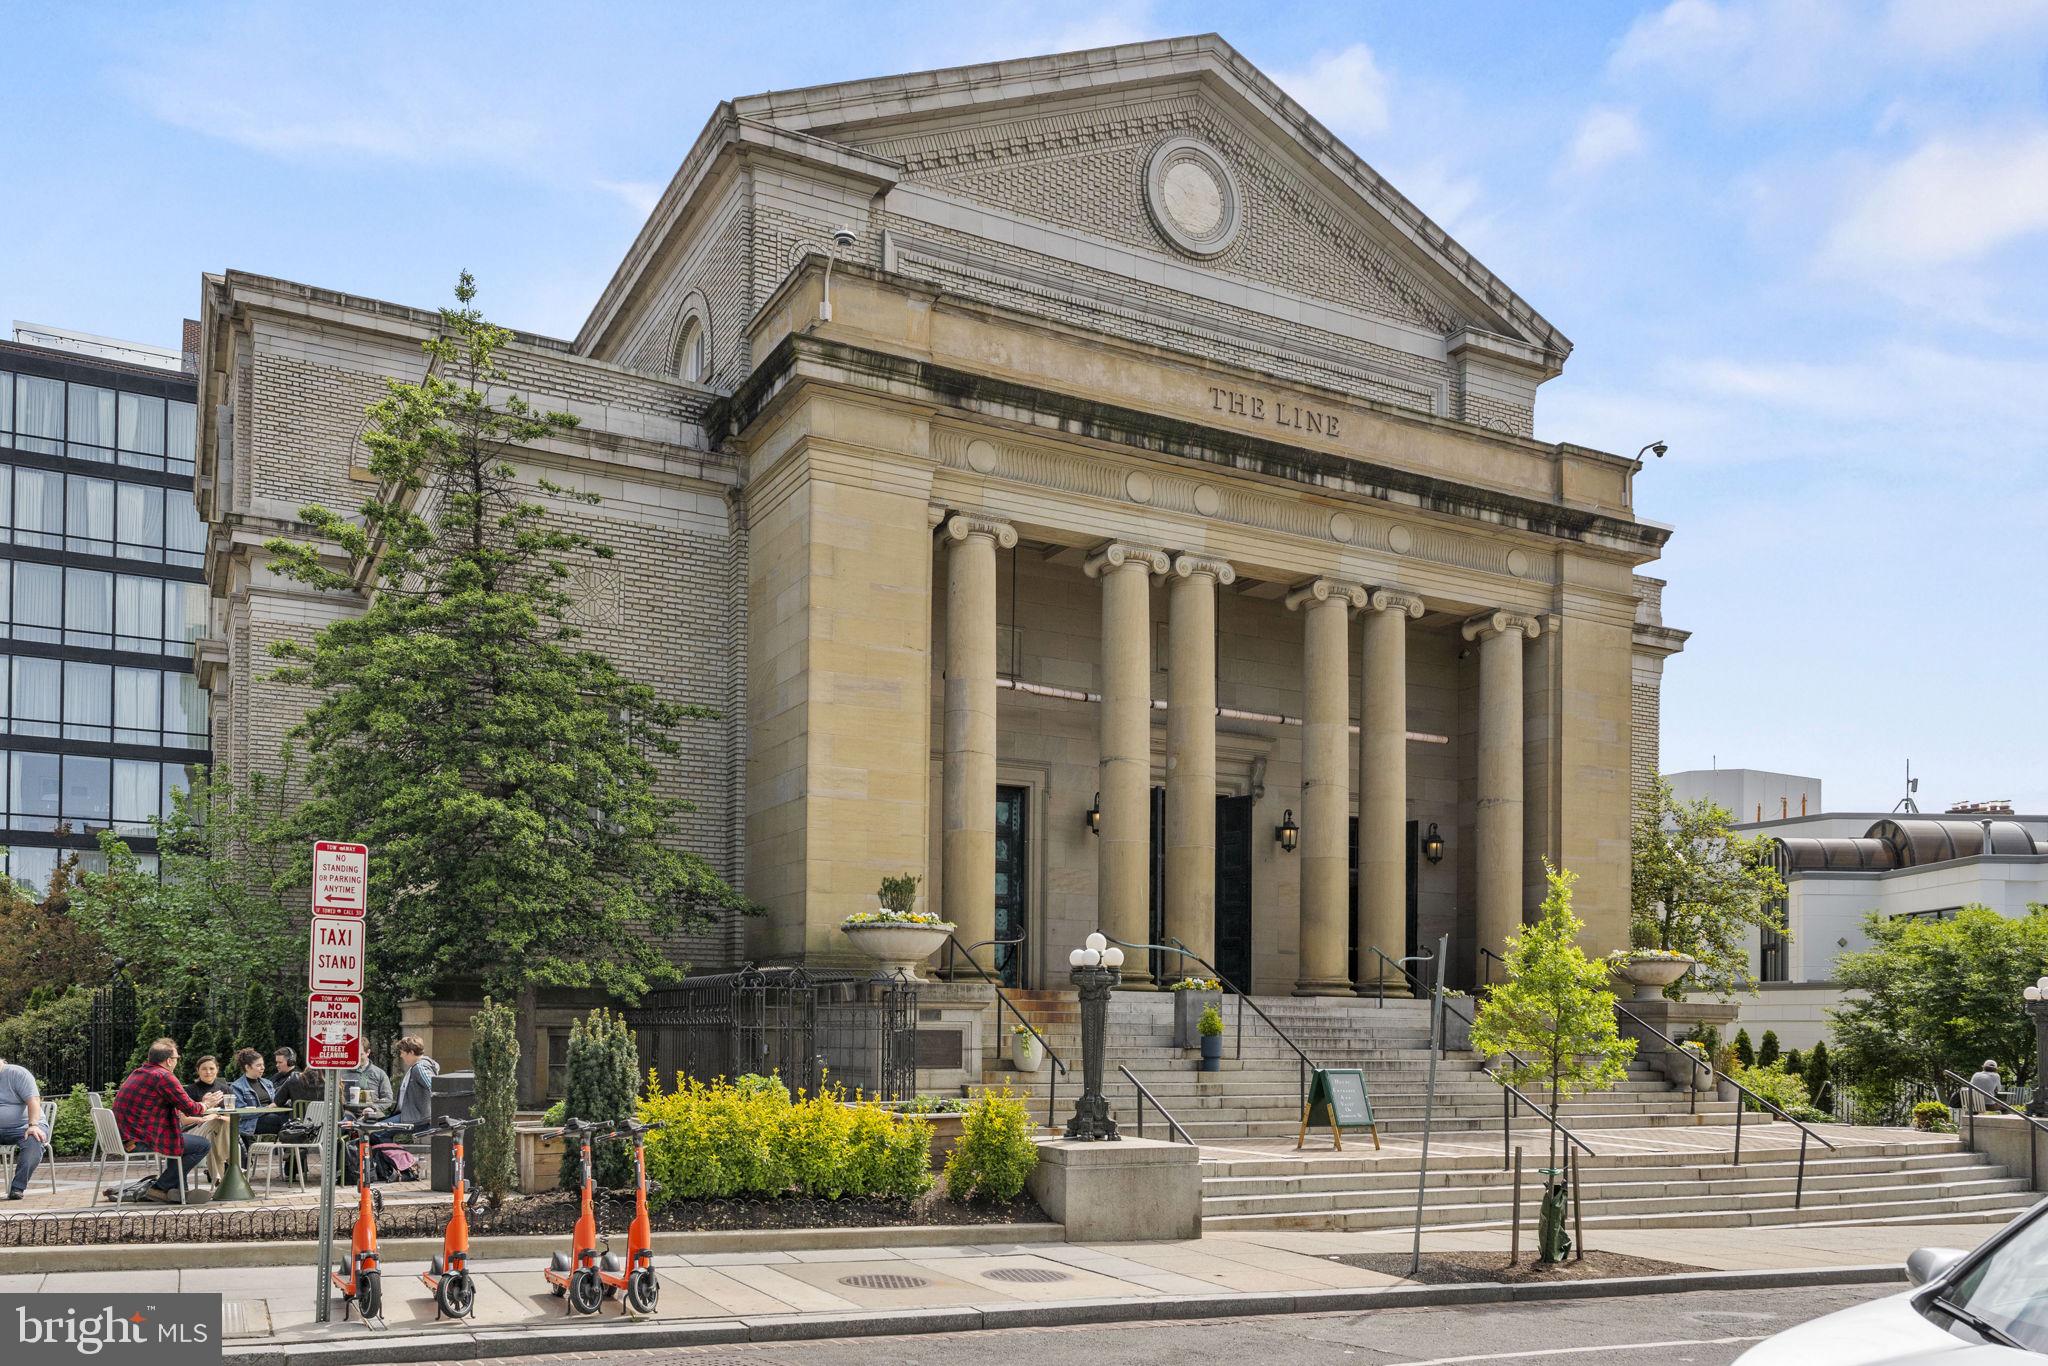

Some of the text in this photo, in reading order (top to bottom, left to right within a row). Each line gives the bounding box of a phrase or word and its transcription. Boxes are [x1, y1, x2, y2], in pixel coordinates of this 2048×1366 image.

[1209, 386, 1340, 438] THE LINE
[335, 854, 346, 862] NO
[322, 863, 359, 873] STANDING
[329, 874, 361, 884] PARKING
[323, 884, 356, 894] ANYTIME
[320, 927, 352, 946] TAXI
[318, 954, 356, 970] STAND
[327, 1003, 343, 1011] NO
[313, 1010, 357, 1020] PARKING
[319, 1051, 349, 1059] CLEANING
